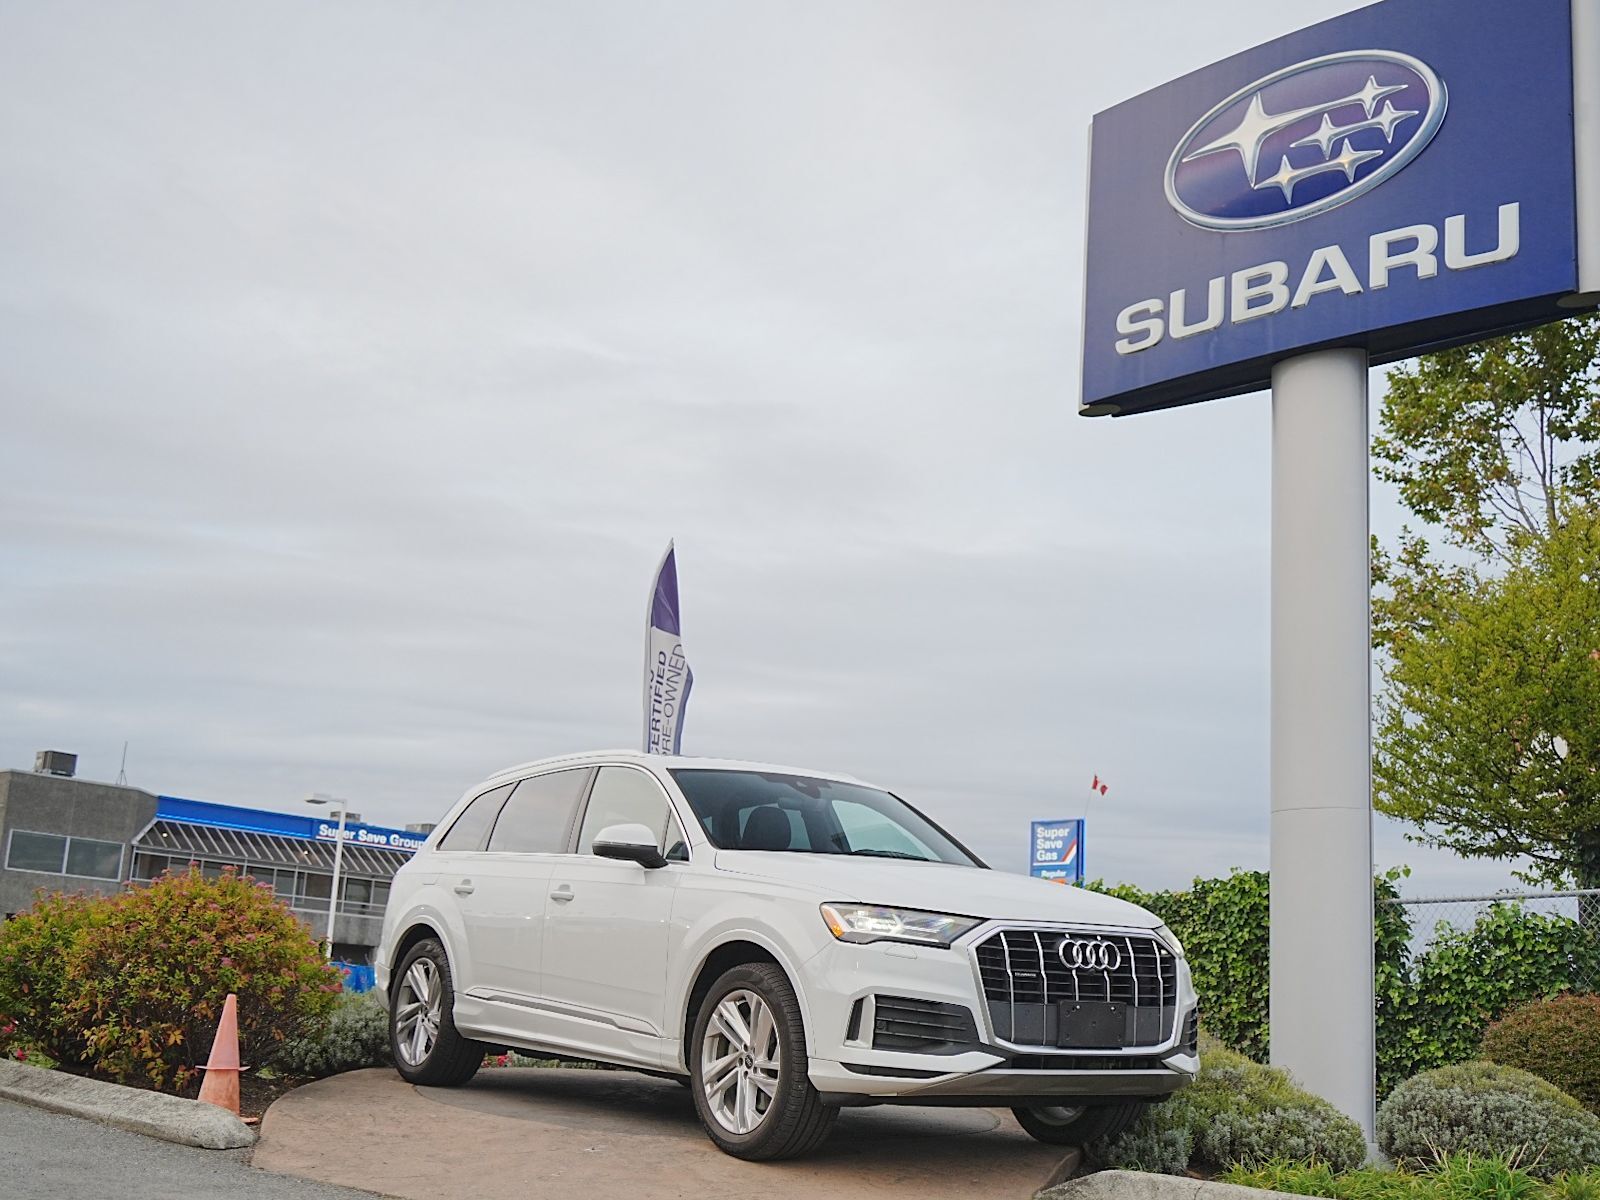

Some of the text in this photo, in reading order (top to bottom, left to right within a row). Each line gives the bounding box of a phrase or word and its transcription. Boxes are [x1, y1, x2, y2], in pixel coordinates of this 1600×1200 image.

[1115, 202, 1520, 355] SUBARU
[319, 824, 356, 840] Suer
[358, 830, 388, 844] Save
[1037, 827, 1069, 839] Super
[1037, 839, 1063, 849] Save
[1037, 850, 1058, 861] Gas
